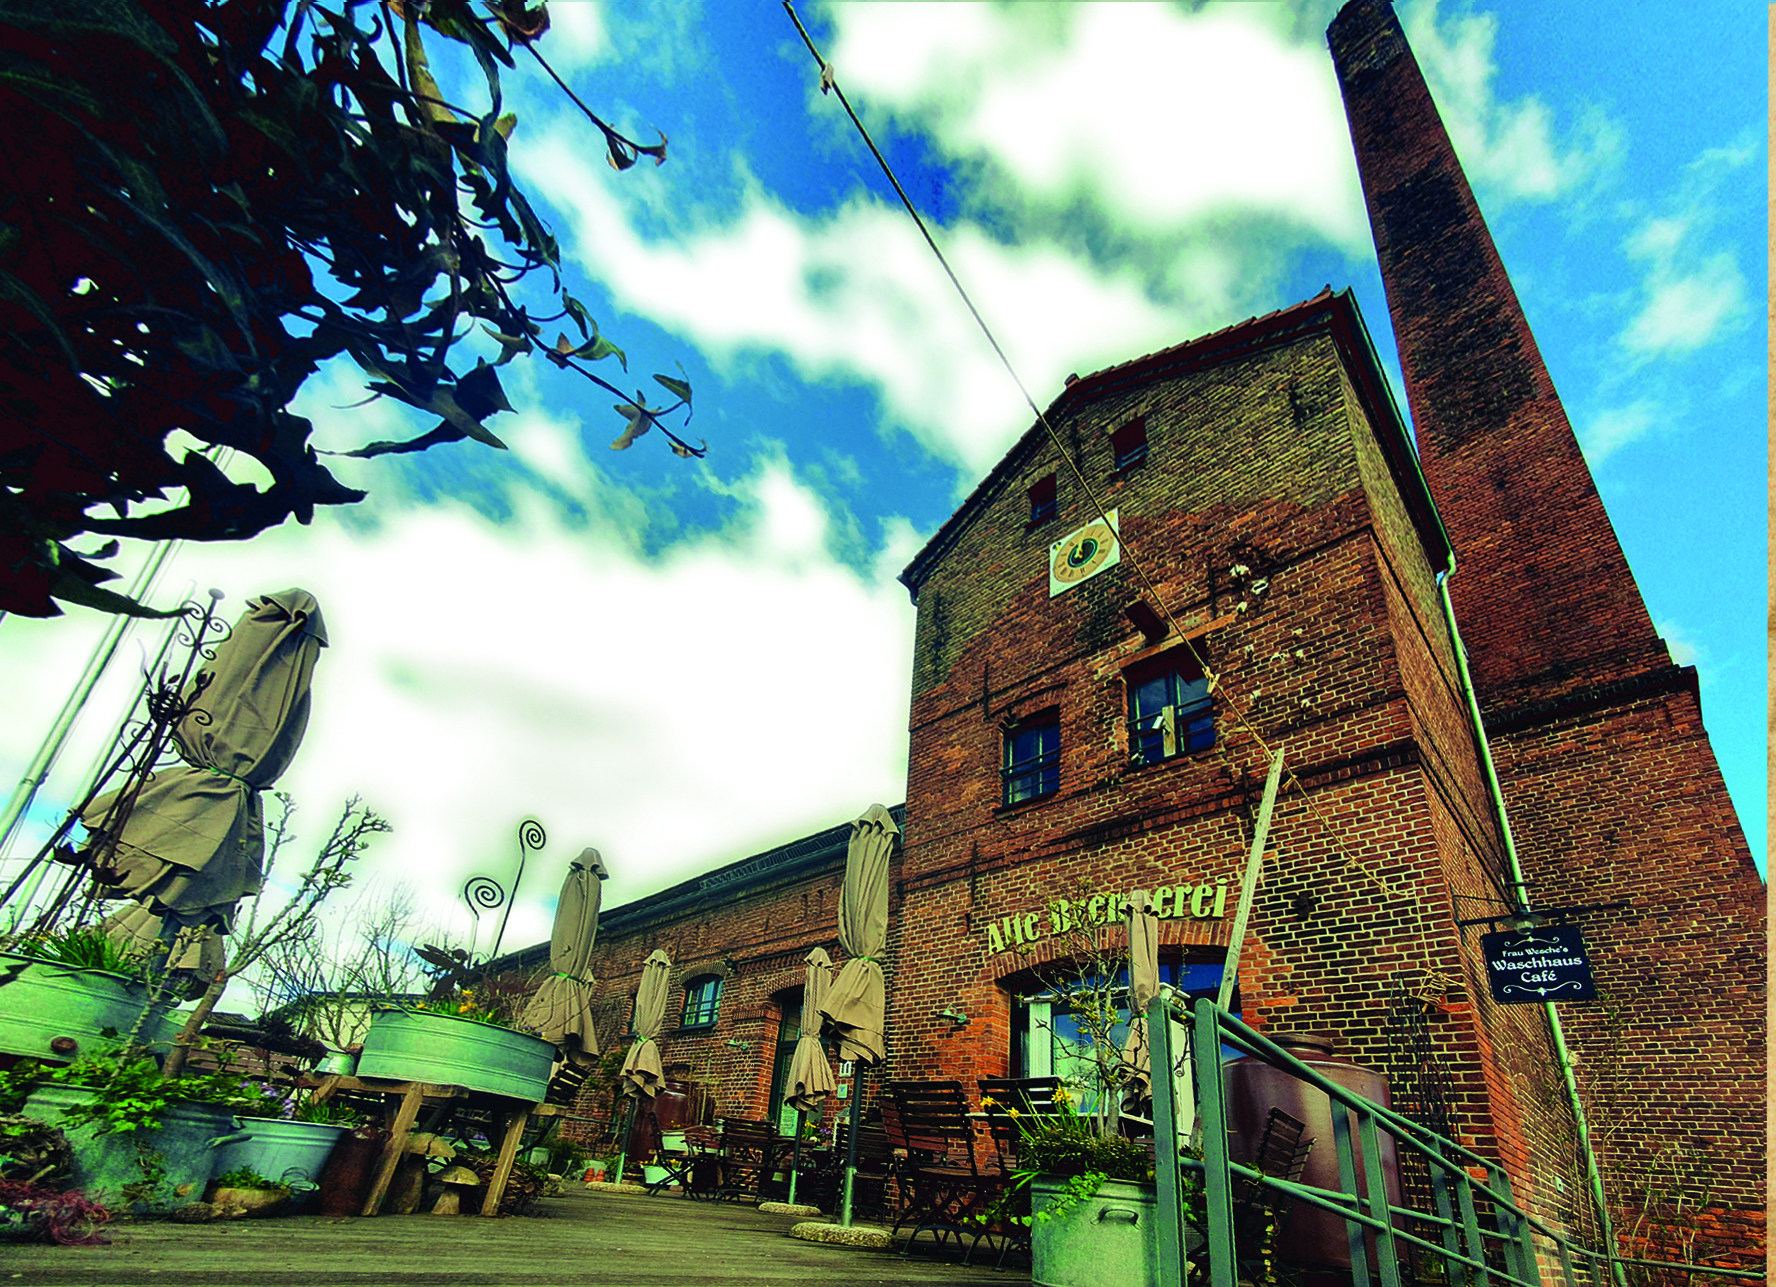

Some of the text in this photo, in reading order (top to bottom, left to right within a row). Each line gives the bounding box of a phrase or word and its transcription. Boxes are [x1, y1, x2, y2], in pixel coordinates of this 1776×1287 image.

[989, 878, 1228, 955] Alte Brenerei
[1491, 956, 1583, 971] Waschhaus
[1521, 970, 1558, 983] Café
